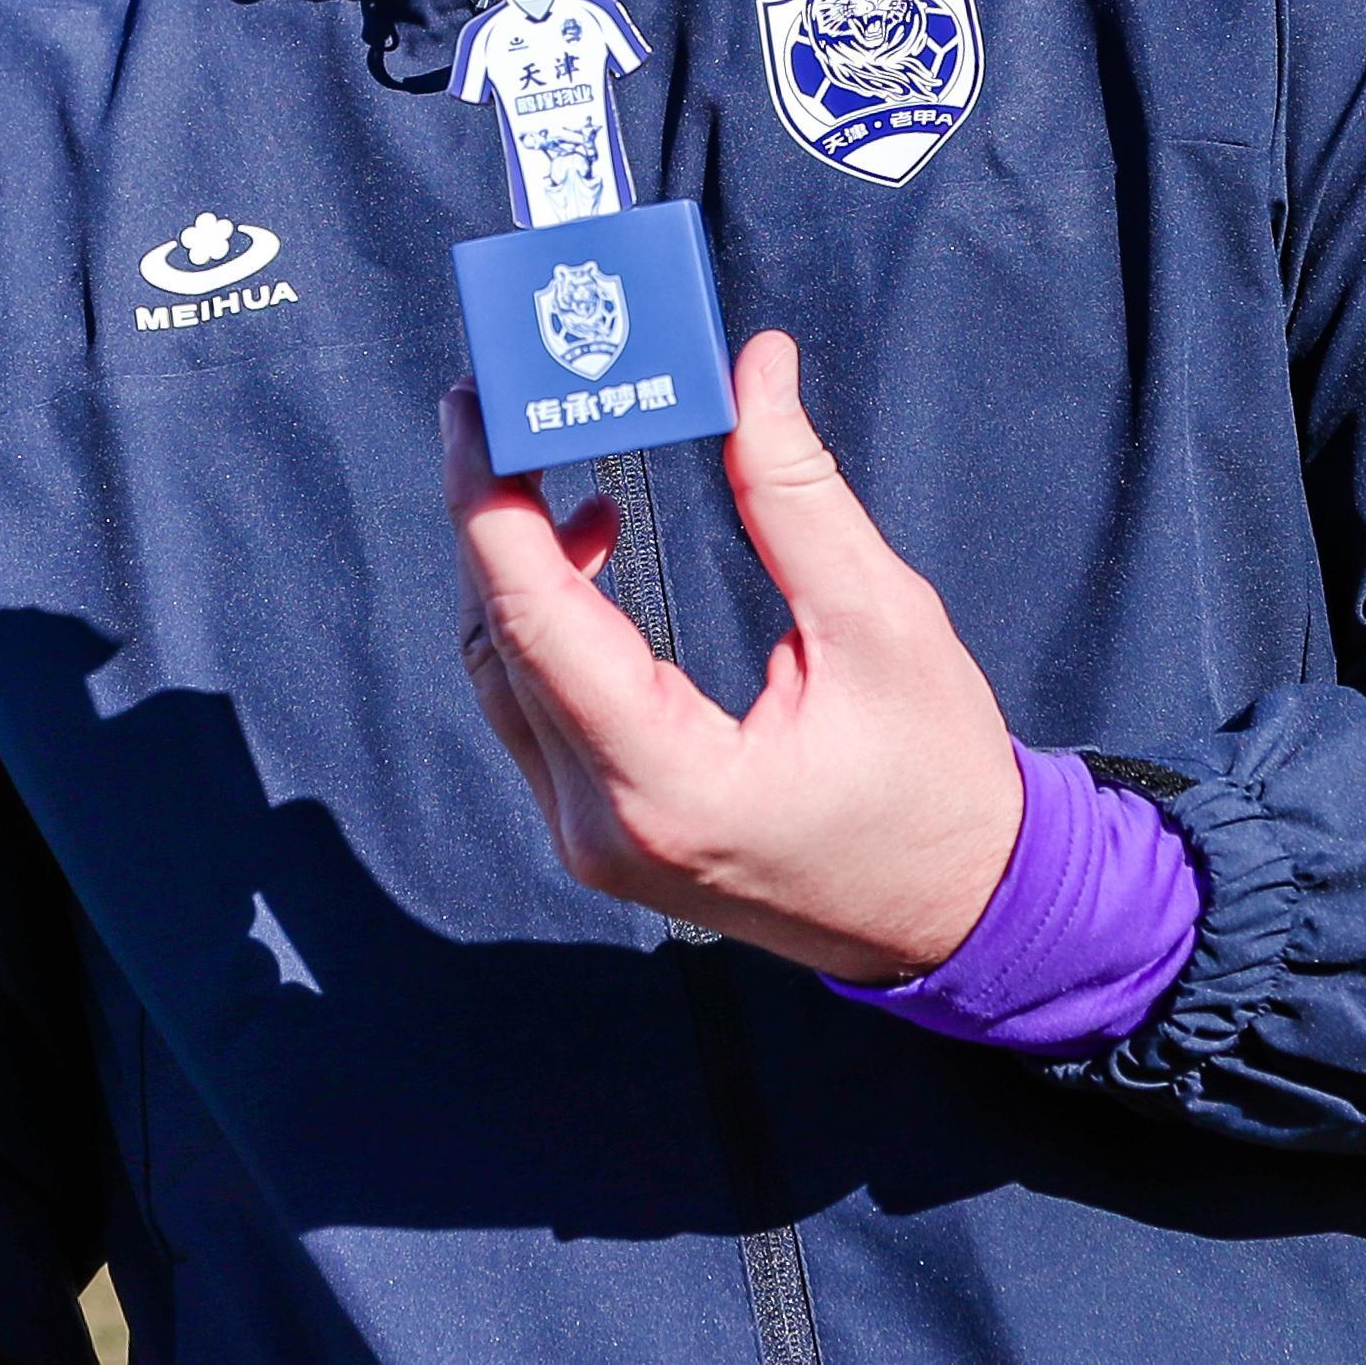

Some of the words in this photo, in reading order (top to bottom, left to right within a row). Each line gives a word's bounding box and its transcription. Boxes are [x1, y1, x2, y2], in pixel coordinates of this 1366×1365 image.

[519, 52, 580, 90] 天津
[135, 282, 299, 331] MEIHUA
[525, 375, 677, 433] 传承梦想
